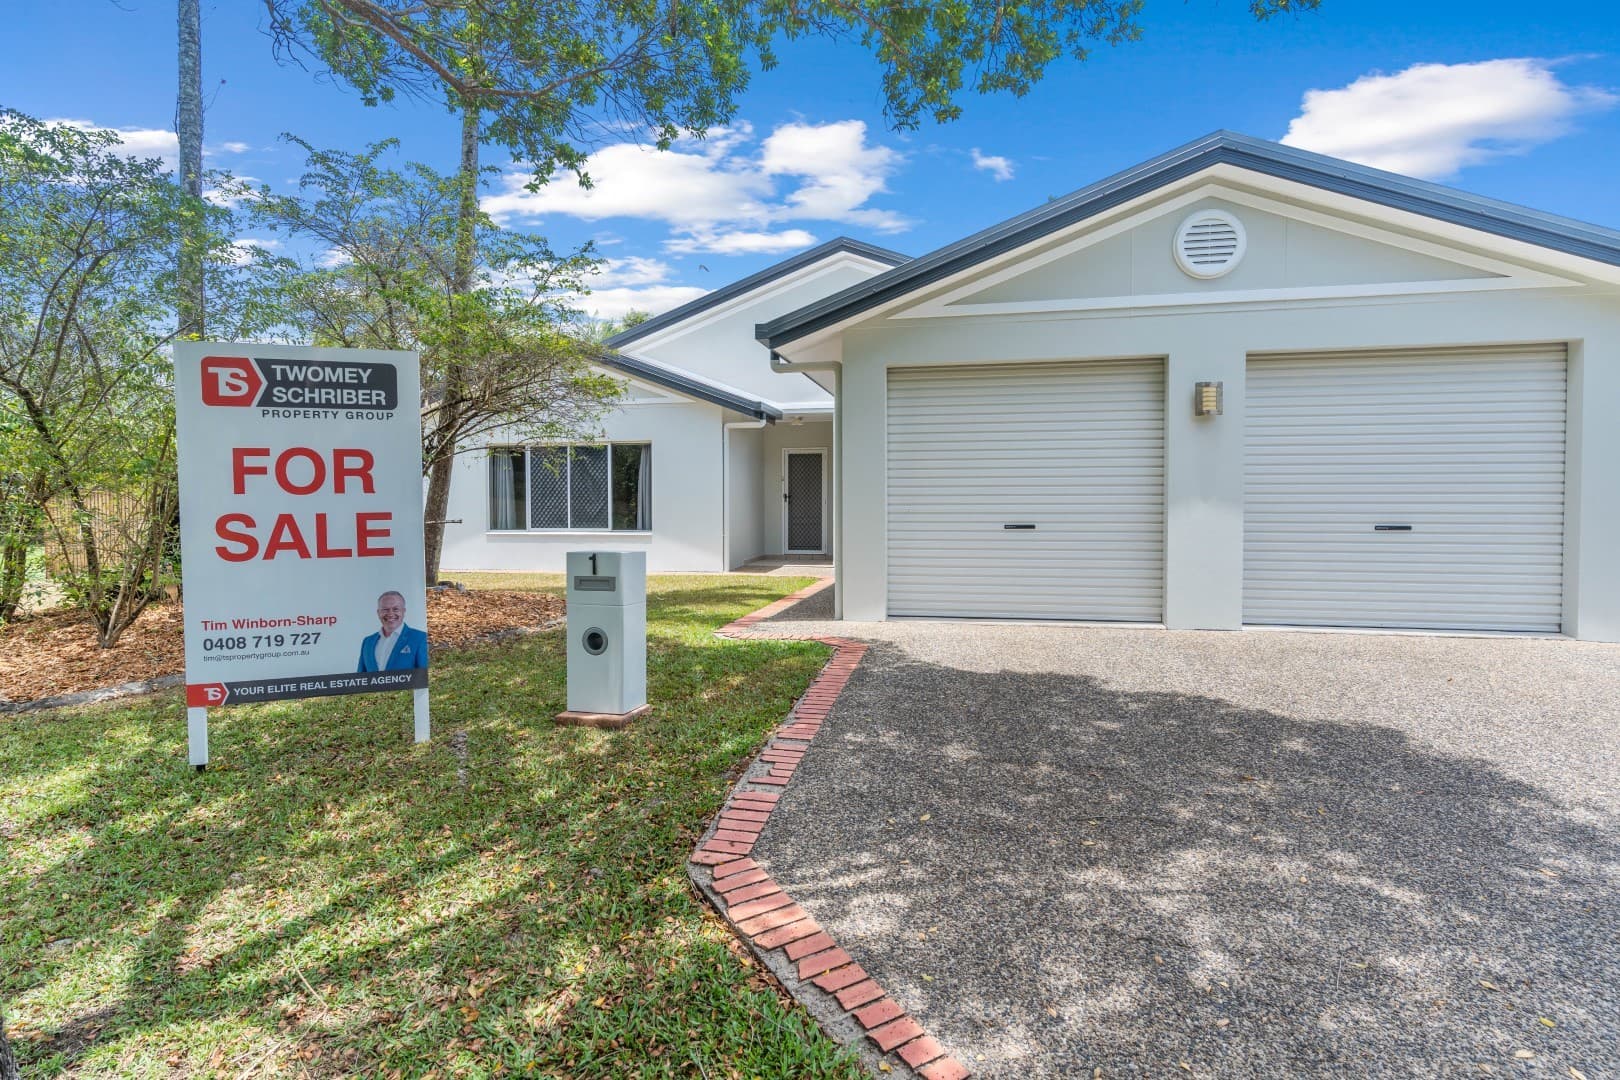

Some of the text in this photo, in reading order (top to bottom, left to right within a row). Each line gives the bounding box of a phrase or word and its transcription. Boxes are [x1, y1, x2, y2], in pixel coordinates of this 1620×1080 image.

[208, 366, 249, 397] TS
[271, 364, 372, 384] TWOMEY
[272, 386, 386, 406] SCHRIBER
[262, 409, 394, 421] PROPERTY GROUP
[232, 447, 376, 495] FOR
[215, 512, 395, 563] SALE
[588, 553, 597, 575] 1
[201, 615, 337, 631] Tim Winborn-Sharp
[203, 632, 321, 651] 0408 719 727
[203, 650, 310, 662] tim@tspropertygroup.com.au
[204, 687, 222, 701] TS
[233, 674, 412, 696] YOUR ELITE REAL ESTATE AGENCY
